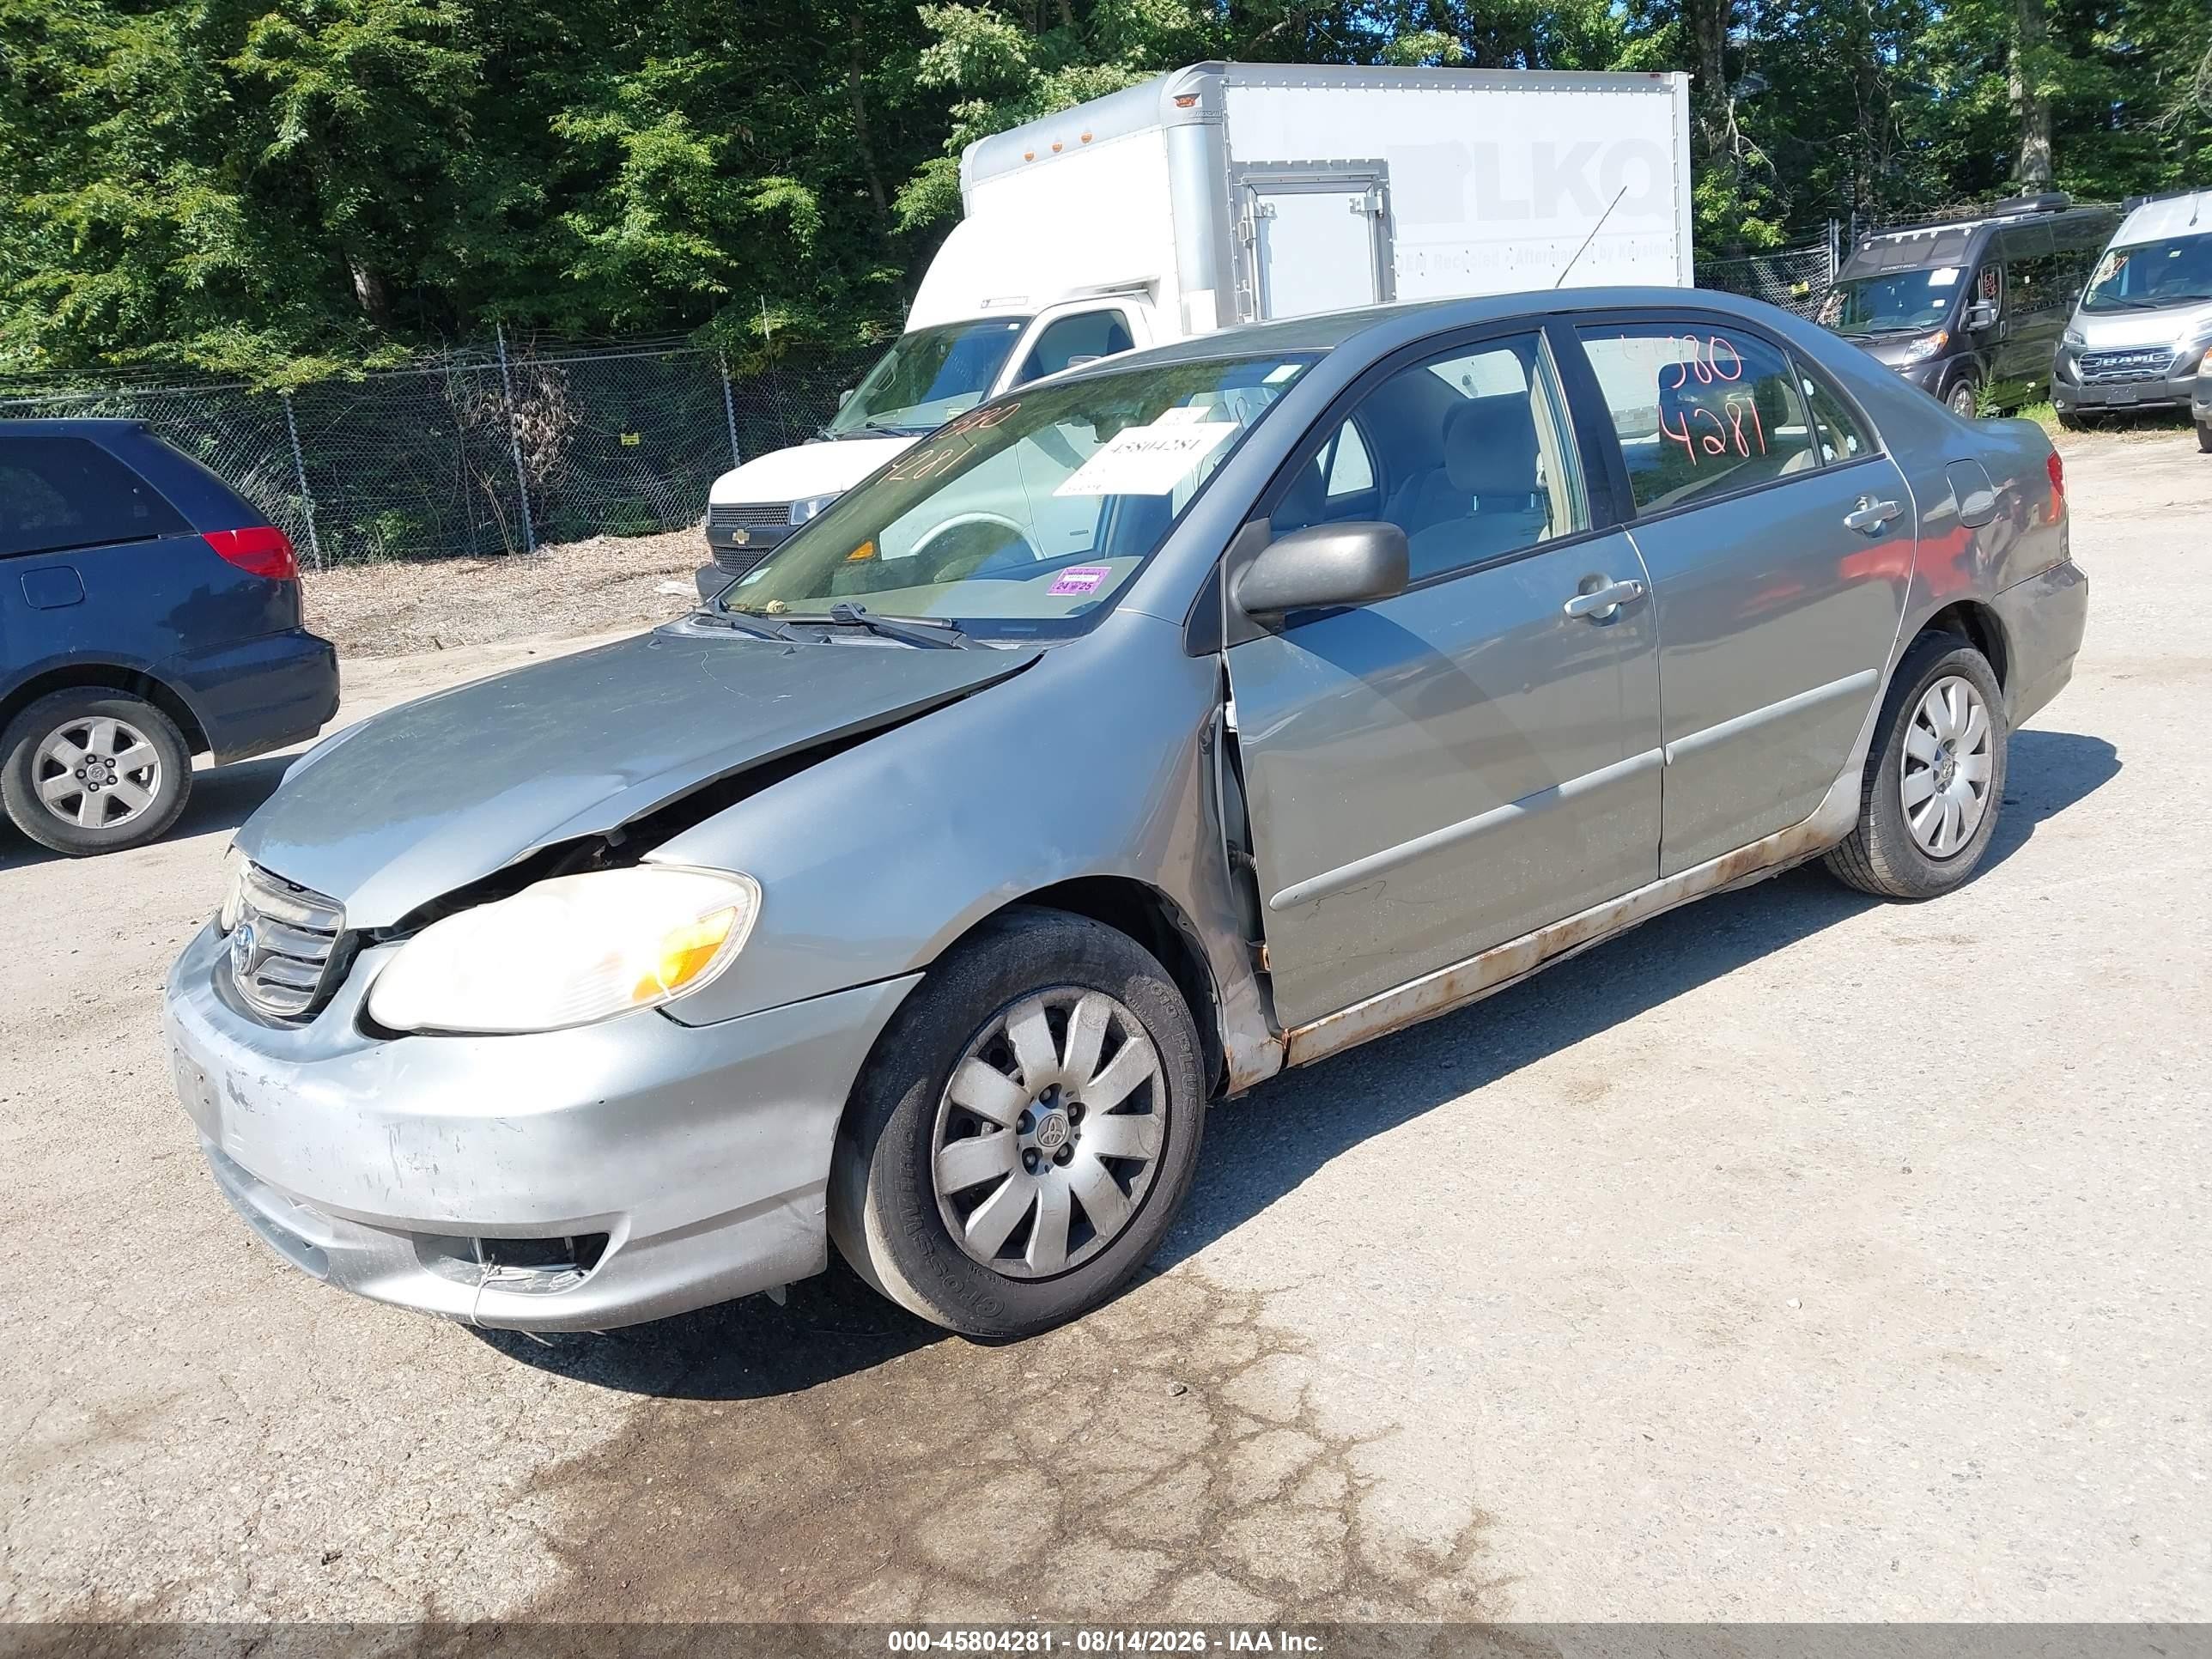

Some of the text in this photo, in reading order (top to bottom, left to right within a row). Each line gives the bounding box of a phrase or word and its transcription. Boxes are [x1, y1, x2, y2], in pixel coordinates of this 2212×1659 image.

[1474, 138, 1673, 222] LKQ
[2103, 355, 2150, 367] RAM
[1659, 397, 1765, 466] 4281
[875, 443, 977, 485] 4281
[1079, 582, 1094, 591] 25
